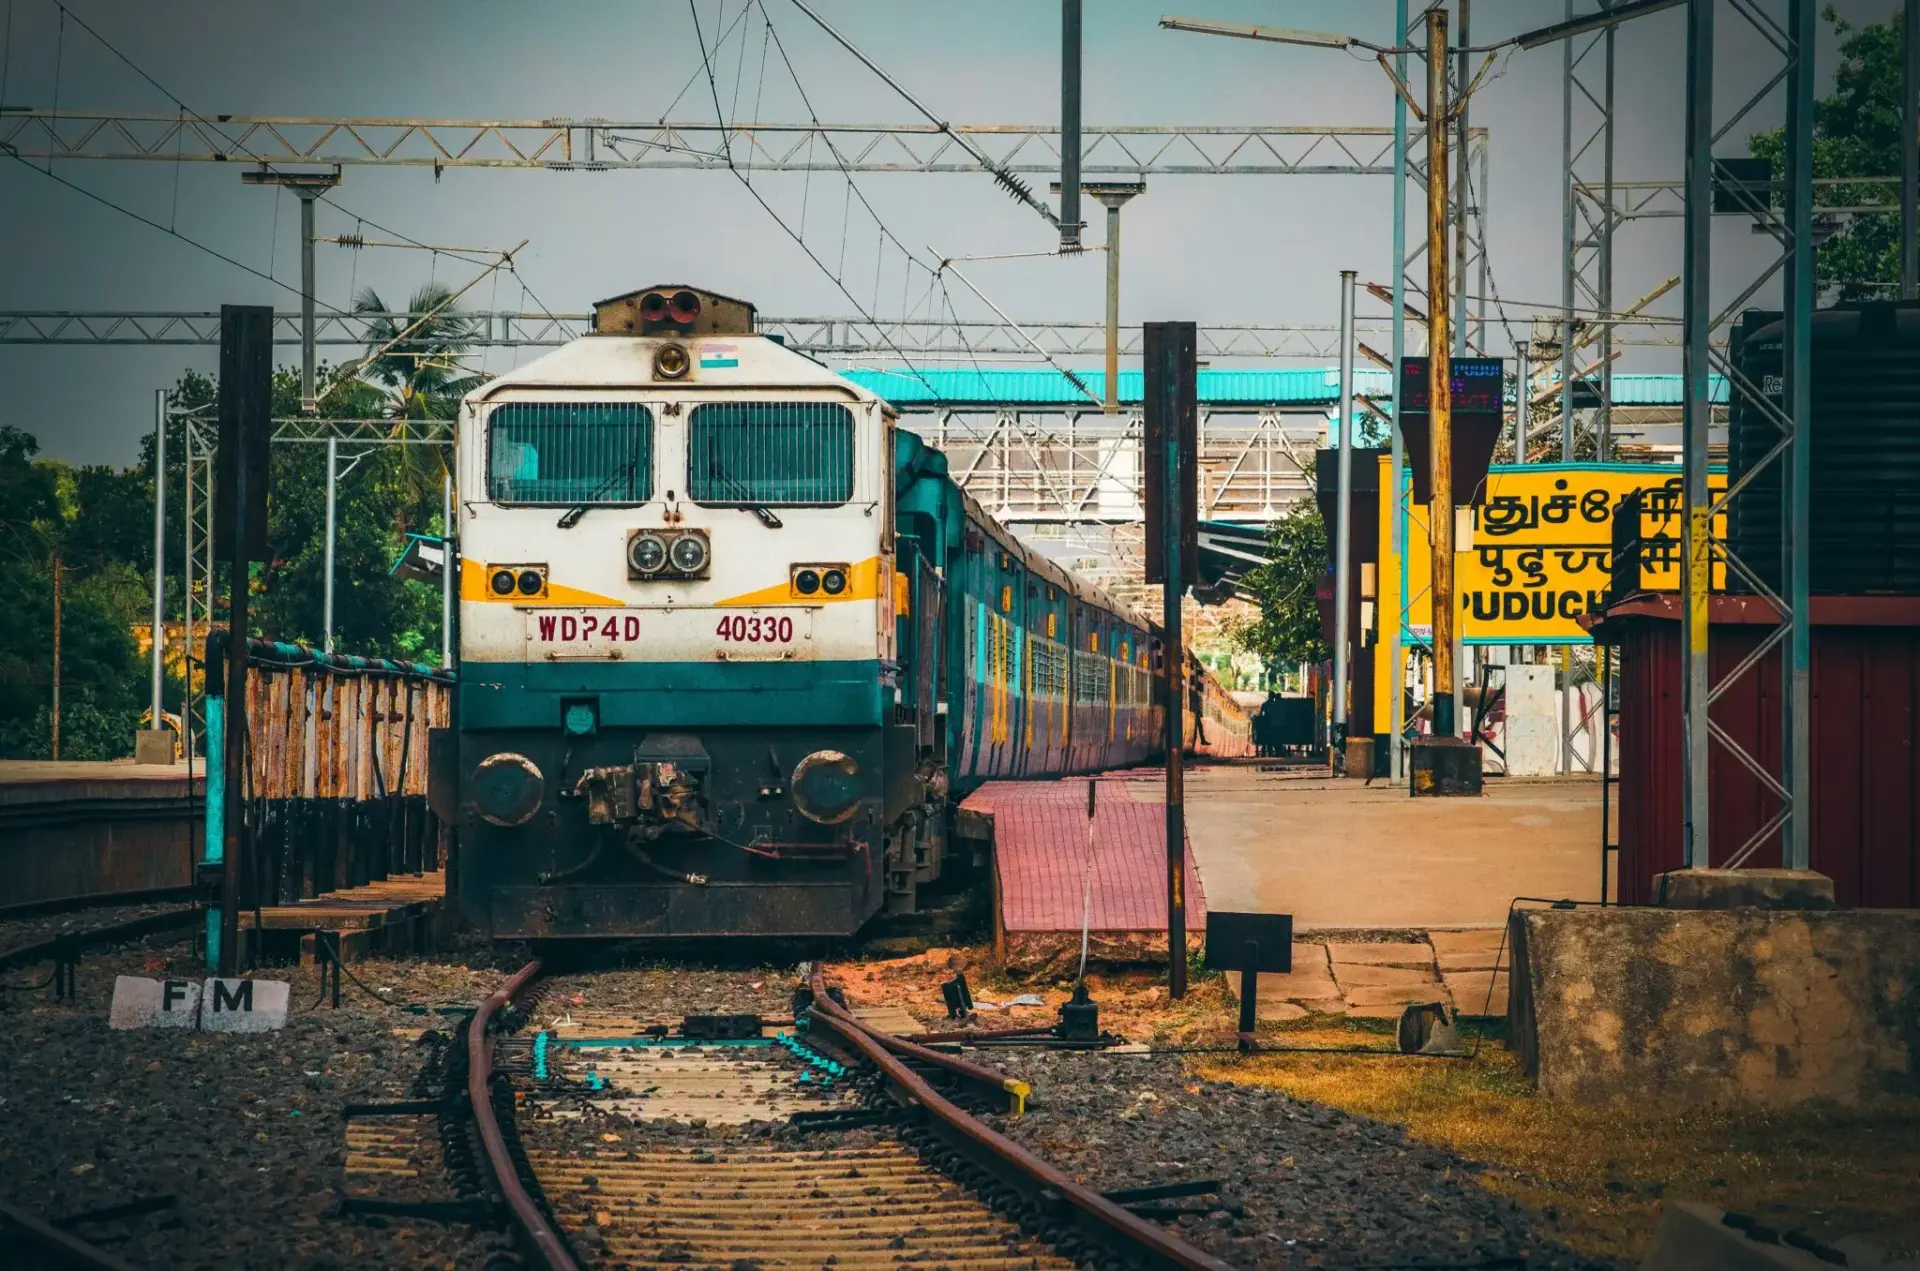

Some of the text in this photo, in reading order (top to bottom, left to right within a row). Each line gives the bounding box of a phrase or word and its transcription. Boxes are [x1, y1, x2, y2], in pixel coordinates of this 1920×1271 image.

[1763, 375, 1784, 394] Re
[716, 615, 793, 643] 40330
[162, 980, 253, 1013] F M
